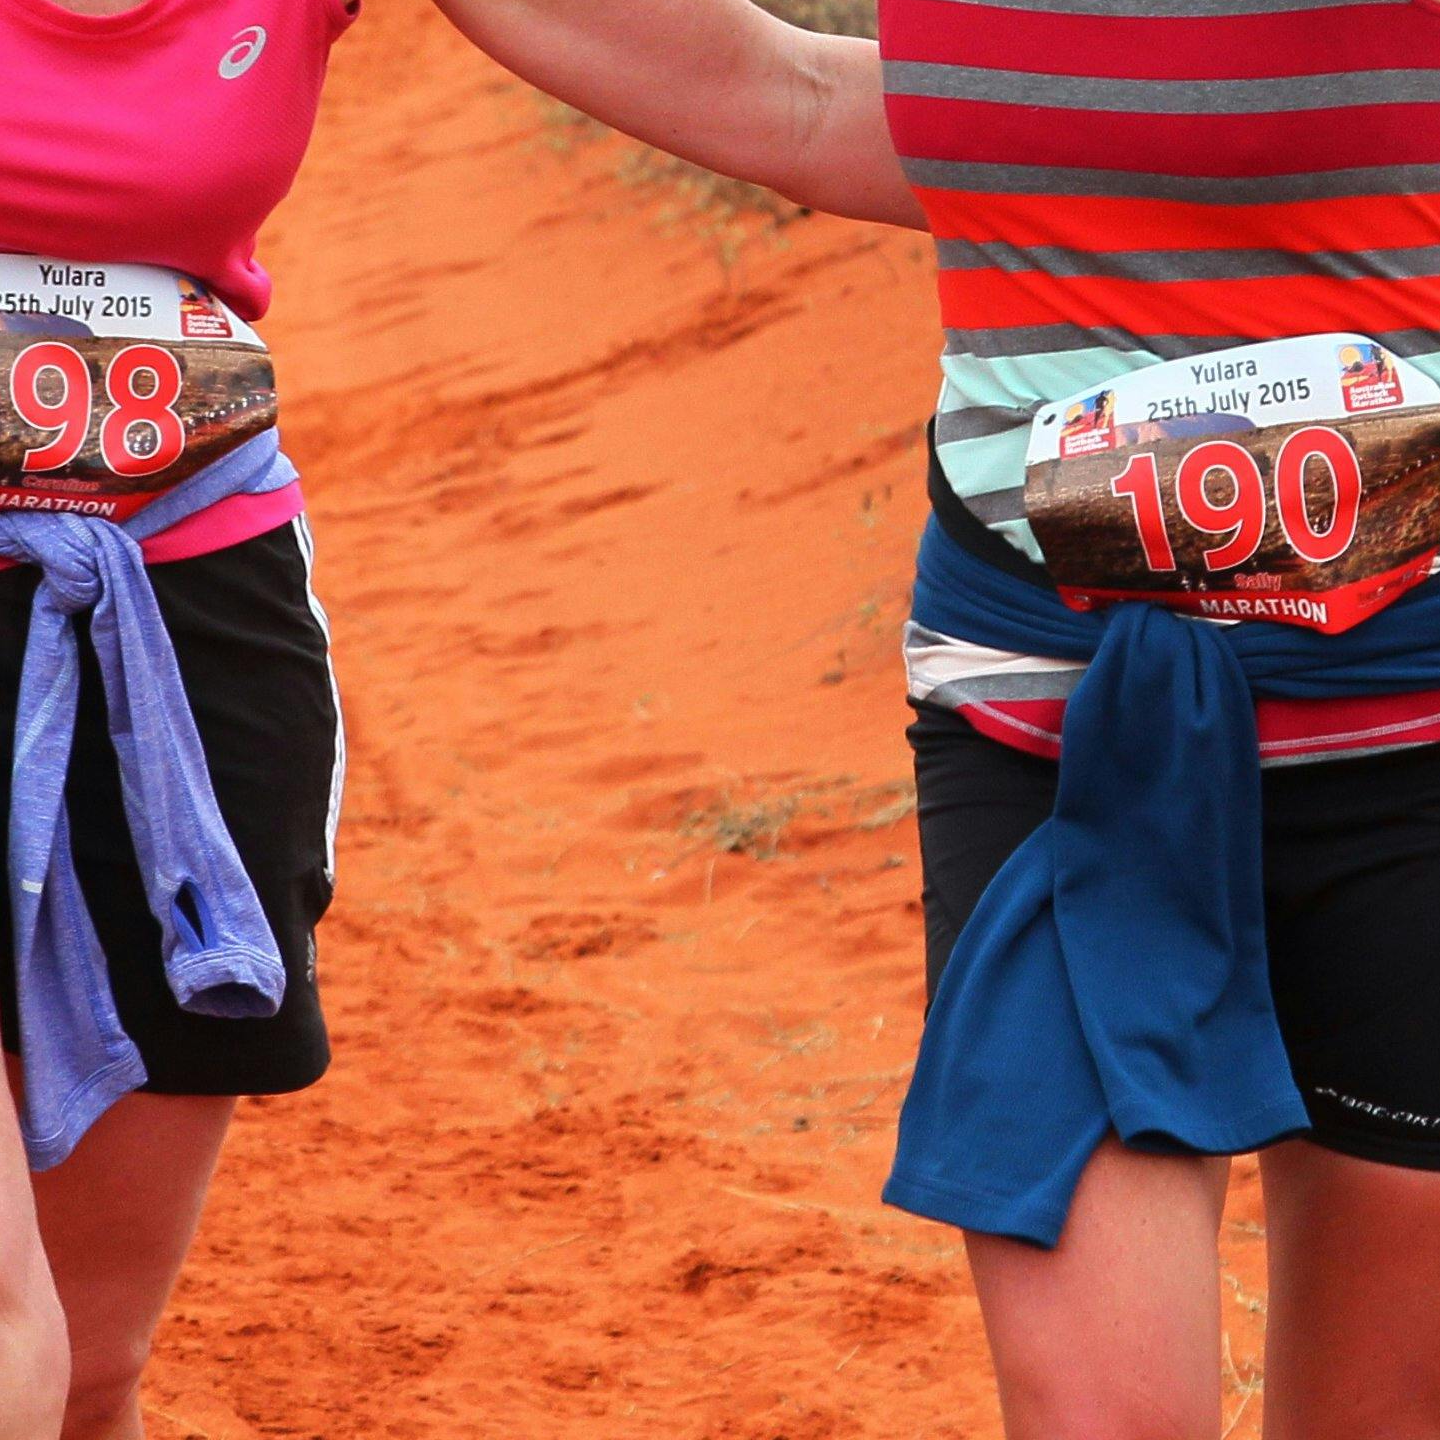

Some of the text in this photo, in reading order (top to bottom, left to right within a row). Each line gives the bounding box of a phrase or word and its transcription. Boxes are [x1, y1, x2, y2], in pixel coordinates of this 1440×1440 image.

[39, 264, 106, 287] Yulara
[48, 294, 94, 321] July
[101, 296, 152, 318] 2015
[1190, 359, 1258, 385] Yulara
[1147, 377, 1311, 422] 25th July 2015
[1110, 425, 1362, 572] 190
[1199, 598, 1328, 625] MARATHON
